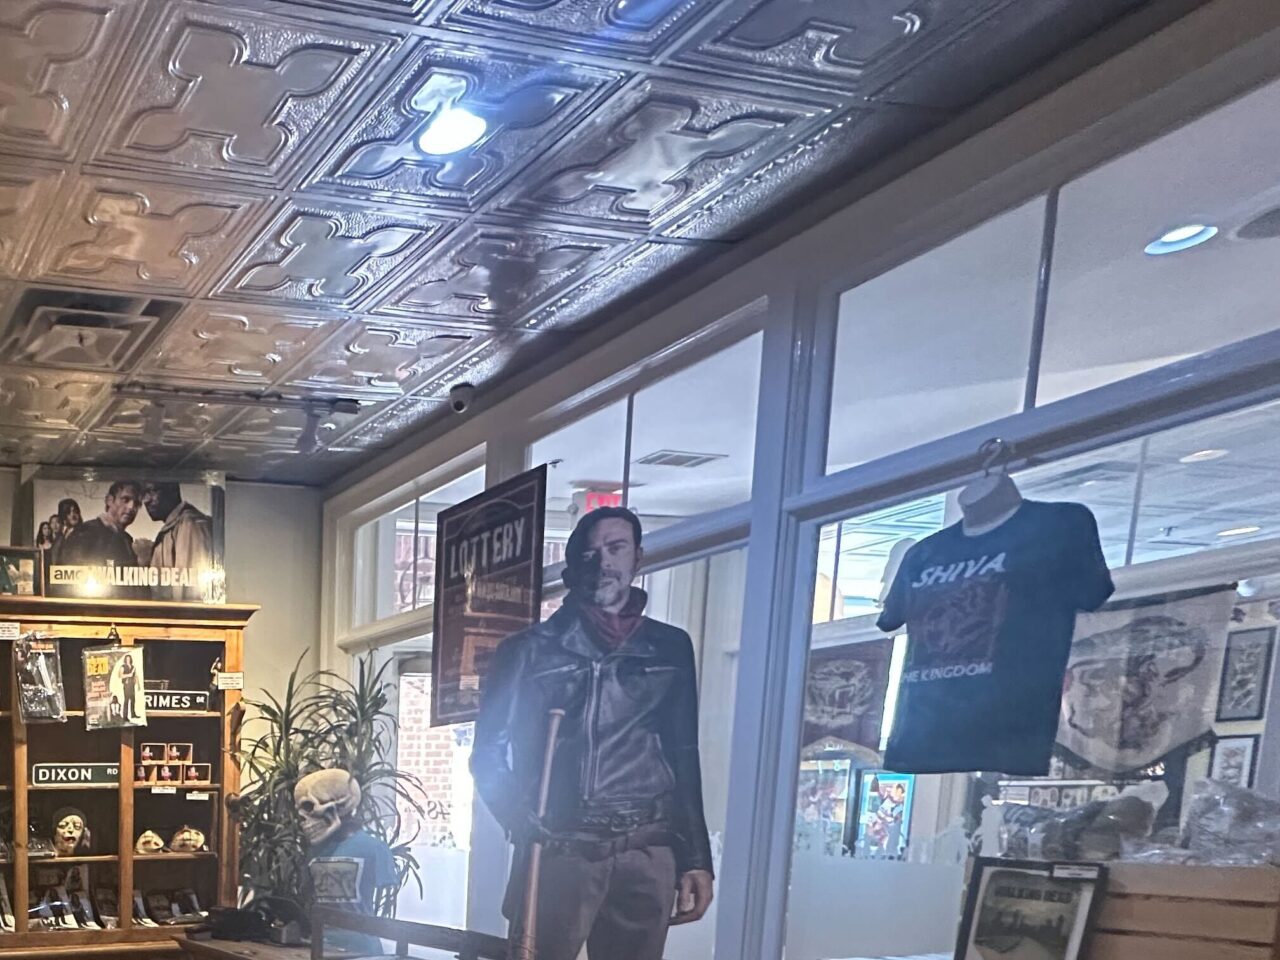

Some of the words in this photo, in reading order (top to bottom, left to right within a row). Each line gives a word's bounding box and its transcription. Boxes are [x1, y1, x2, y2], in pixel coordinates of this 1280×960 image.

[450, 517, 525, 578] LOTTERY
[97, 566, 158, 586] WALKING
[912, 552, 1006, 588] SHIVA
[921, 662, 993, 681] KINGDOM
[145, 695, 190, 708] RIMES
[38, 768, 92, 781] DIXON
[106, 767, 118, 775] RD
